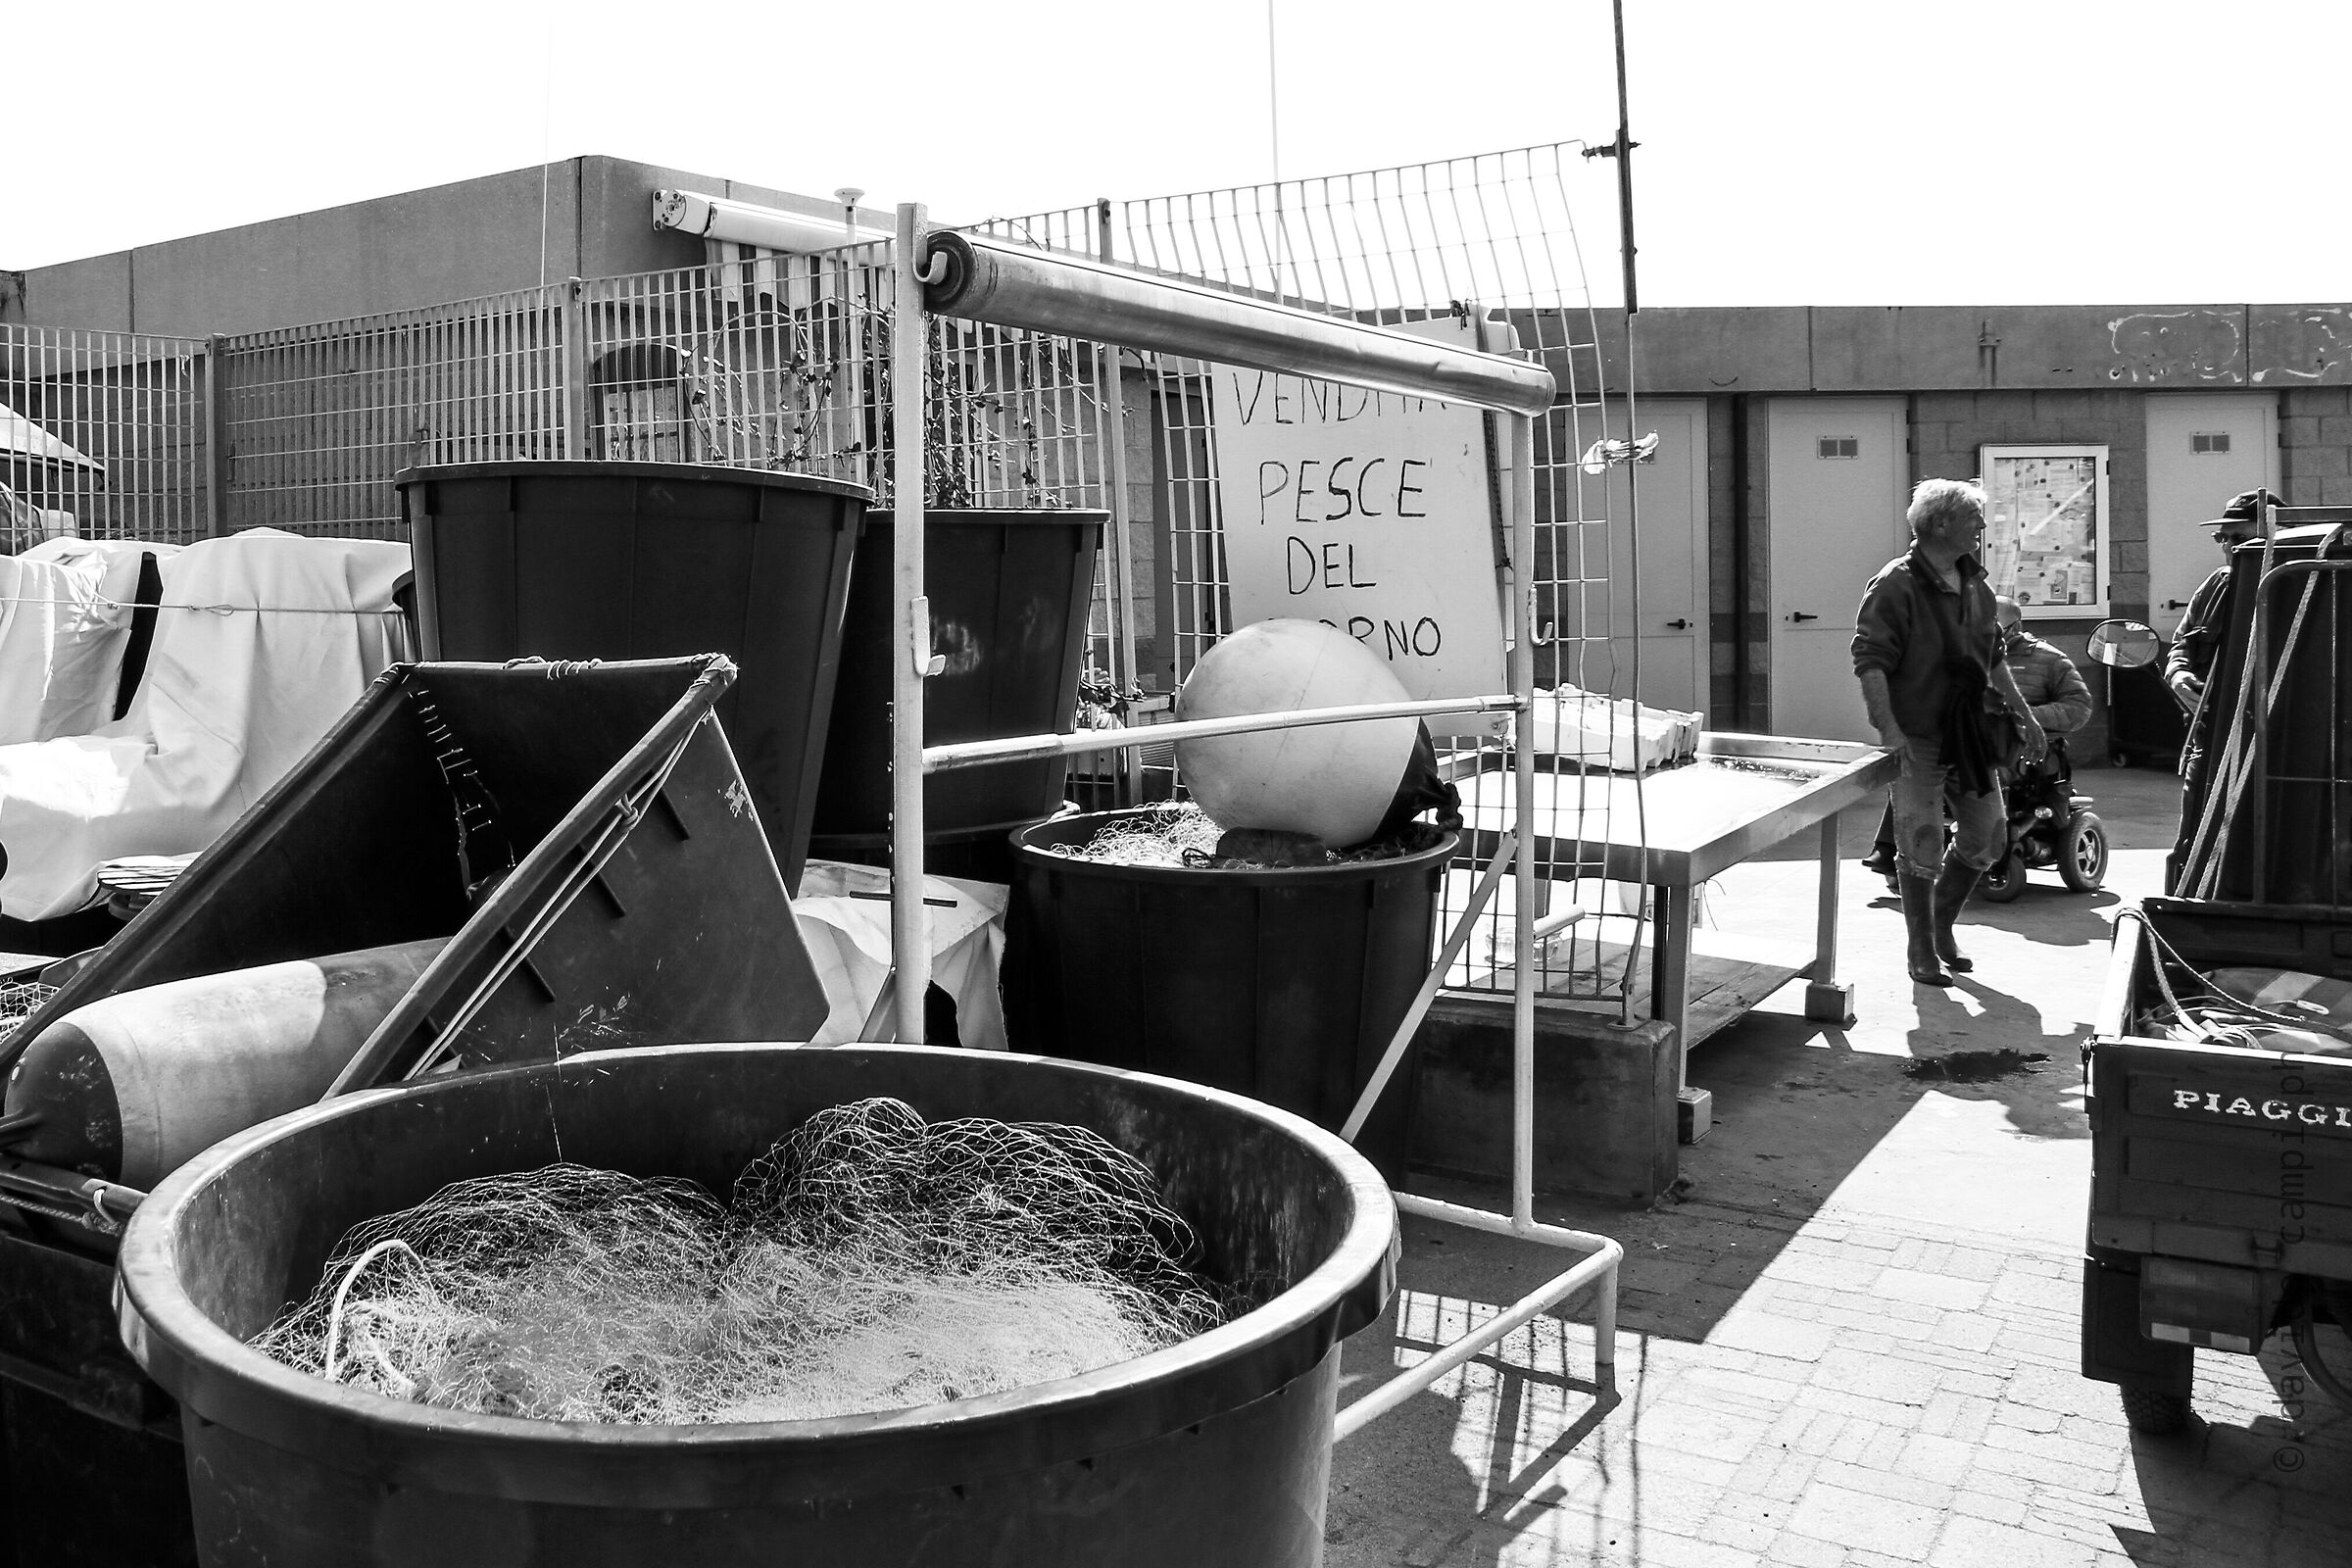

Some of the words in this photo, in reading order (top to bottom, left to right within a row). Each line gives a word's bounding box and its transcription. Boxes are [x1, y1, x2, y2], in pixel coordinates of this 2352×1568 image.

[1259, 457, 1427, 525] PESCE
[1287, 536, 1377, 595] DEL
[2173, 1089, 2352, 1128] PIAGGI
